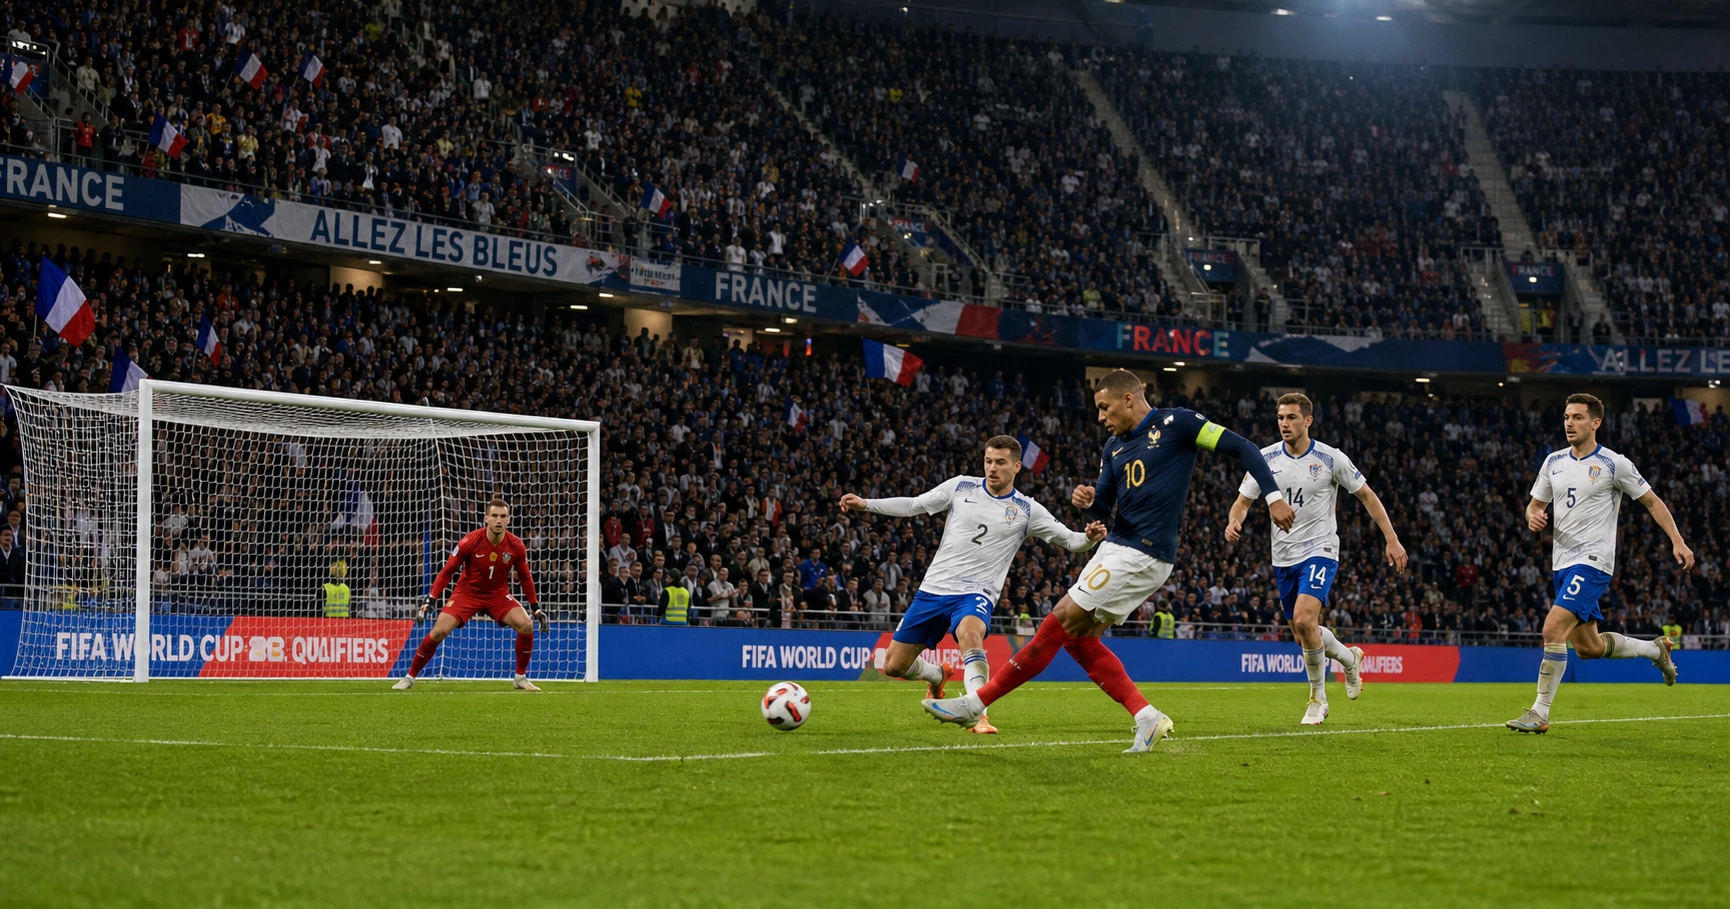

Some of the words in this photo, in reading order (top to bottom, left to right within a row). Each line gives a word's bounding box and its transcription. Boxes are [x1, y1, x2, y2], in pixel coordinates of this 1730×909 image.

[0, 157, 125, 211] RANCE
[310, 209, 407, 255] ALLEZ
[415, 224, 464, 263] LES
[473, 234, 558, 277] BLEUS
[715, 271, 817, 313] FRANCE
[1116, 323, 1230, 357] FRANCE
[1601, 348, 1691, 373] ALLEZ
[1124, 459, 1146, 489] 10
[1286, 487, 1305, 508] 14
[1566, 487, 1577, 509] 5
[971, 523, 988, 545] 2
[488, 565, 495, 580] 1
[1083, 563, 1111, 591] 10
[1309, 564, 1327, 586] 14
[1566, 574, 1585, 596] 5
[56, 632, 107, 661] FIFA
[112, 633, 195, 662] WRLD
[200, 634, 244, 662] CUP
[291, 636, 389, 665] QUALIFIERS
[742, 645, 777, 669] FIFA
[780, 645, 837, 669] WORLD
[840, 646, 871, 669] CUP
[1241, 653, 1266, 673] FIFA
[1266, 653, 1305, 673] WORLD
